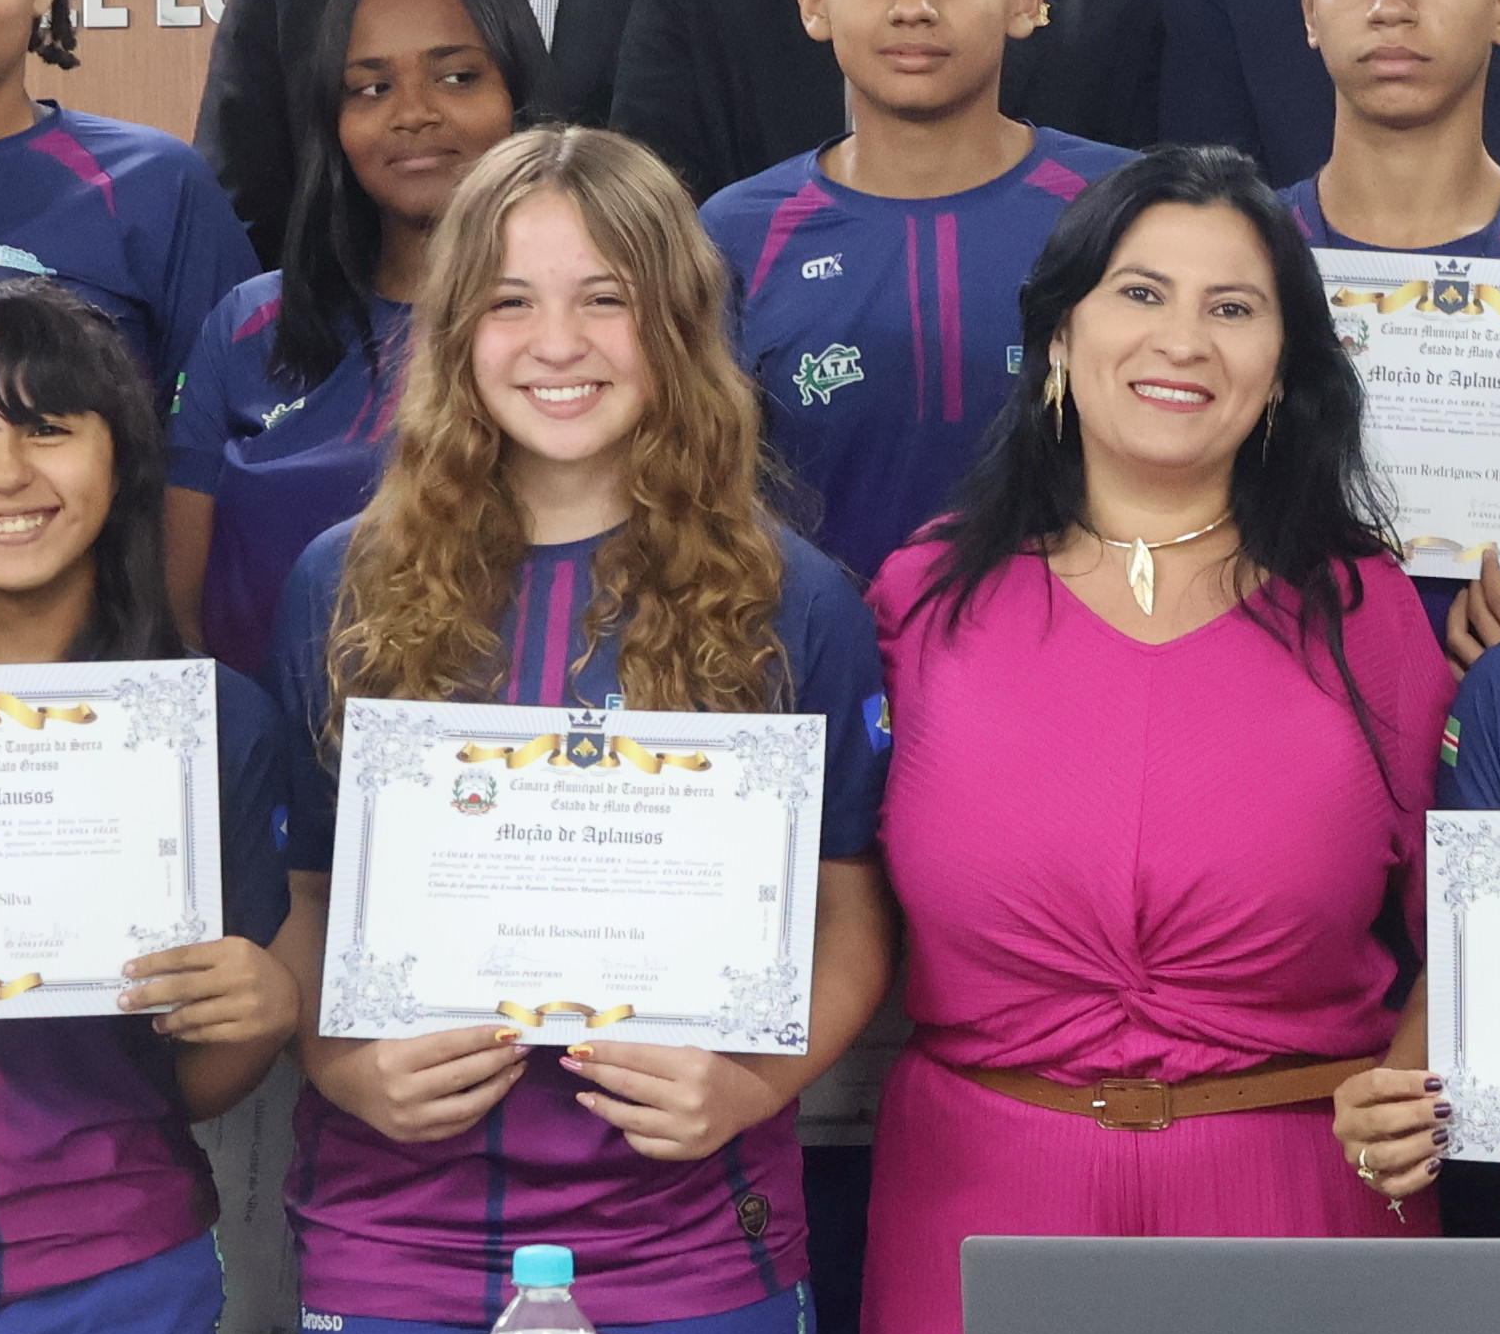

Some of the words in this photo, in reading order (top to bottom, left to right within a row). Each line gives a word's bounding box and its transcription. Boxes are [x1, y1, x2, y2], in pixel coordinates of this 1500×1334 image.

[802, 253, 843, 279] GTX
[1366, 364, 1421, 387] Moção
[1425, 368, 1444, 386] de
[494, 822, 553, 846] Moção
[557, 825, 577, 843] de
[581, 824, 664, 847] Aplausos
